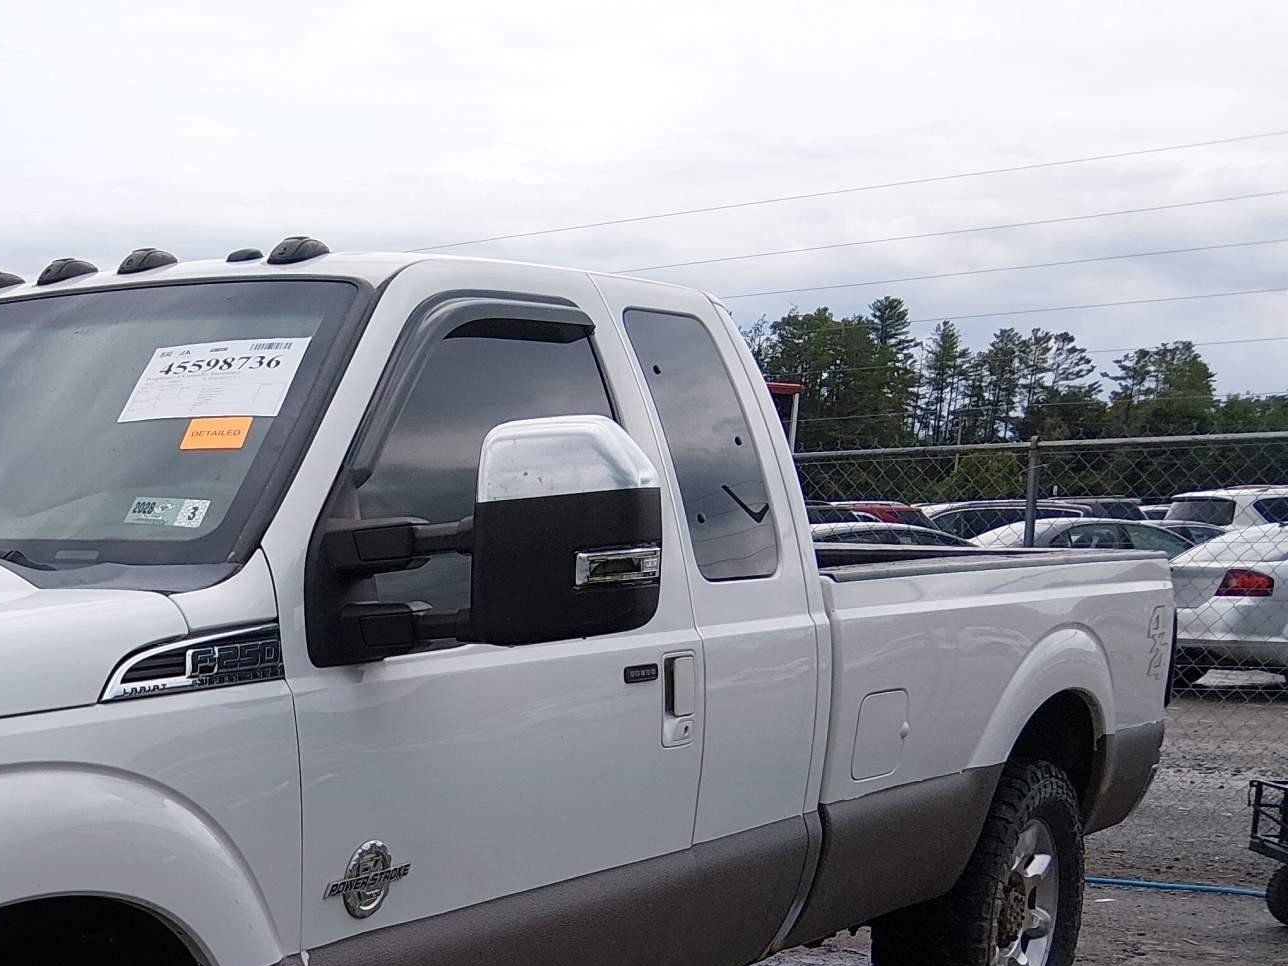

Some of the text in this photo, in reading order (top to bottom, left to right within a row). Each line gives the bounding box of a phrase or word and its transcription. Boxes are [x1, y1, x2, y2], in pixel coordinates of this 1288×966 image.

[159, 355, 285, 375] 45598736
[191, 429, 242, 437] DETAILED
[187, 506, 200, 521] 3
[122, 683, 168, 696] LARIAT
